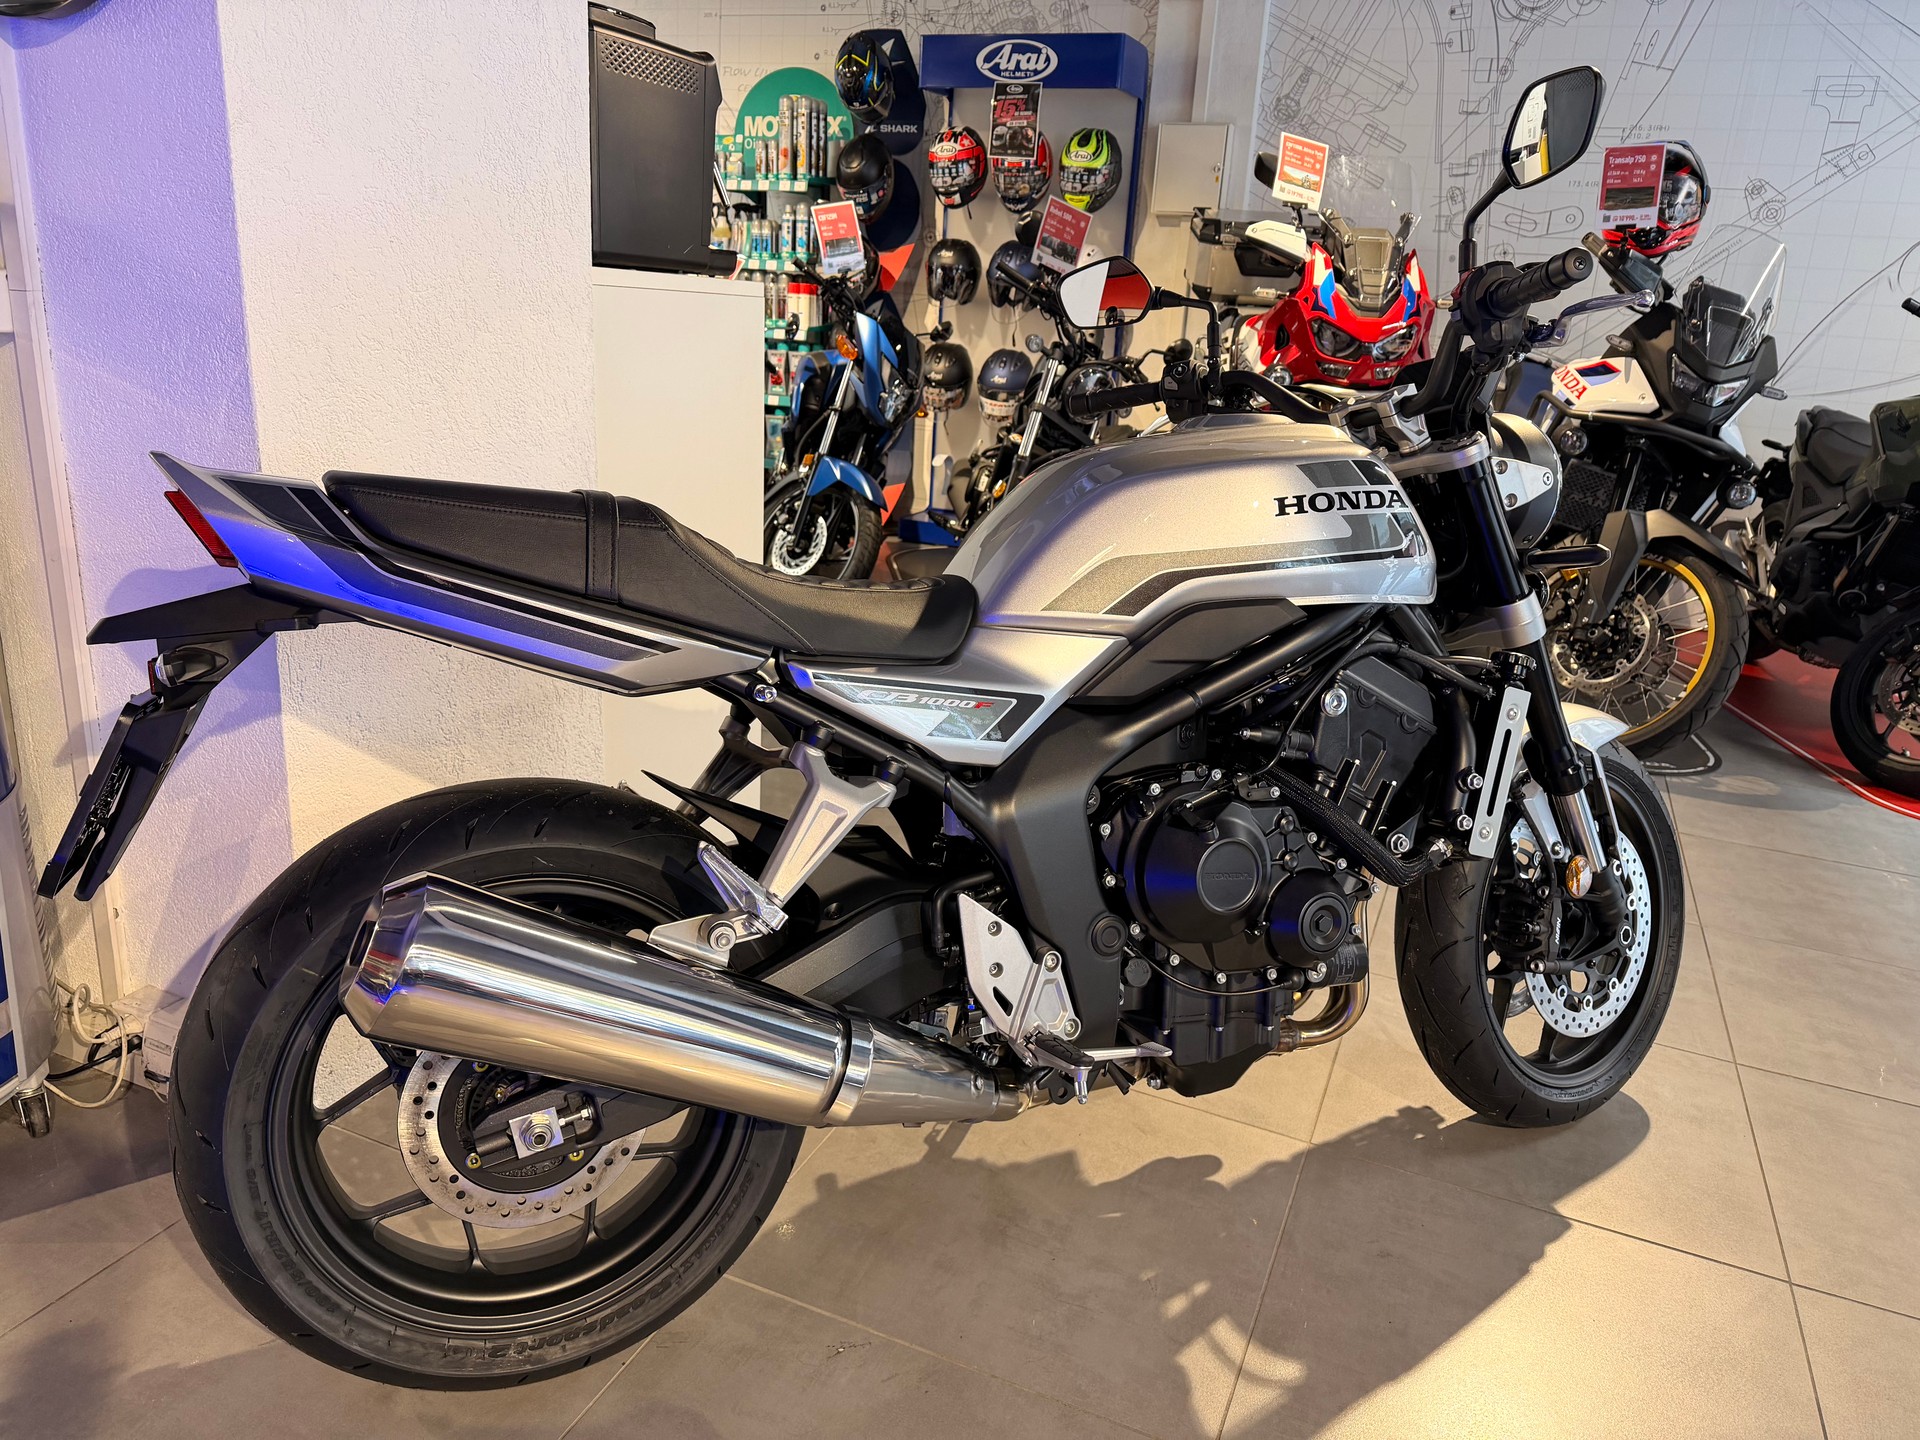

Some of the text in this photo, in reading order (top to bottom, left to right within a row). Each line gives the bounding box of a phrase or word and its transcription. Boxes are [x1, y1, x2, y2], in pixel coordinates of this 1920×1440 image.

[981, 44, 1048, 71] Arai
[880, 125, 918, 133] SHARK
[1071, 152, 1091, 160] Arai
[1609, 155, 1647, 165] Transalp 750
[937, 250, 953, 258] Arai
[1273, 489, 1409, 517] HONDA
[512, 1270, 683, 1357] Roadsport
